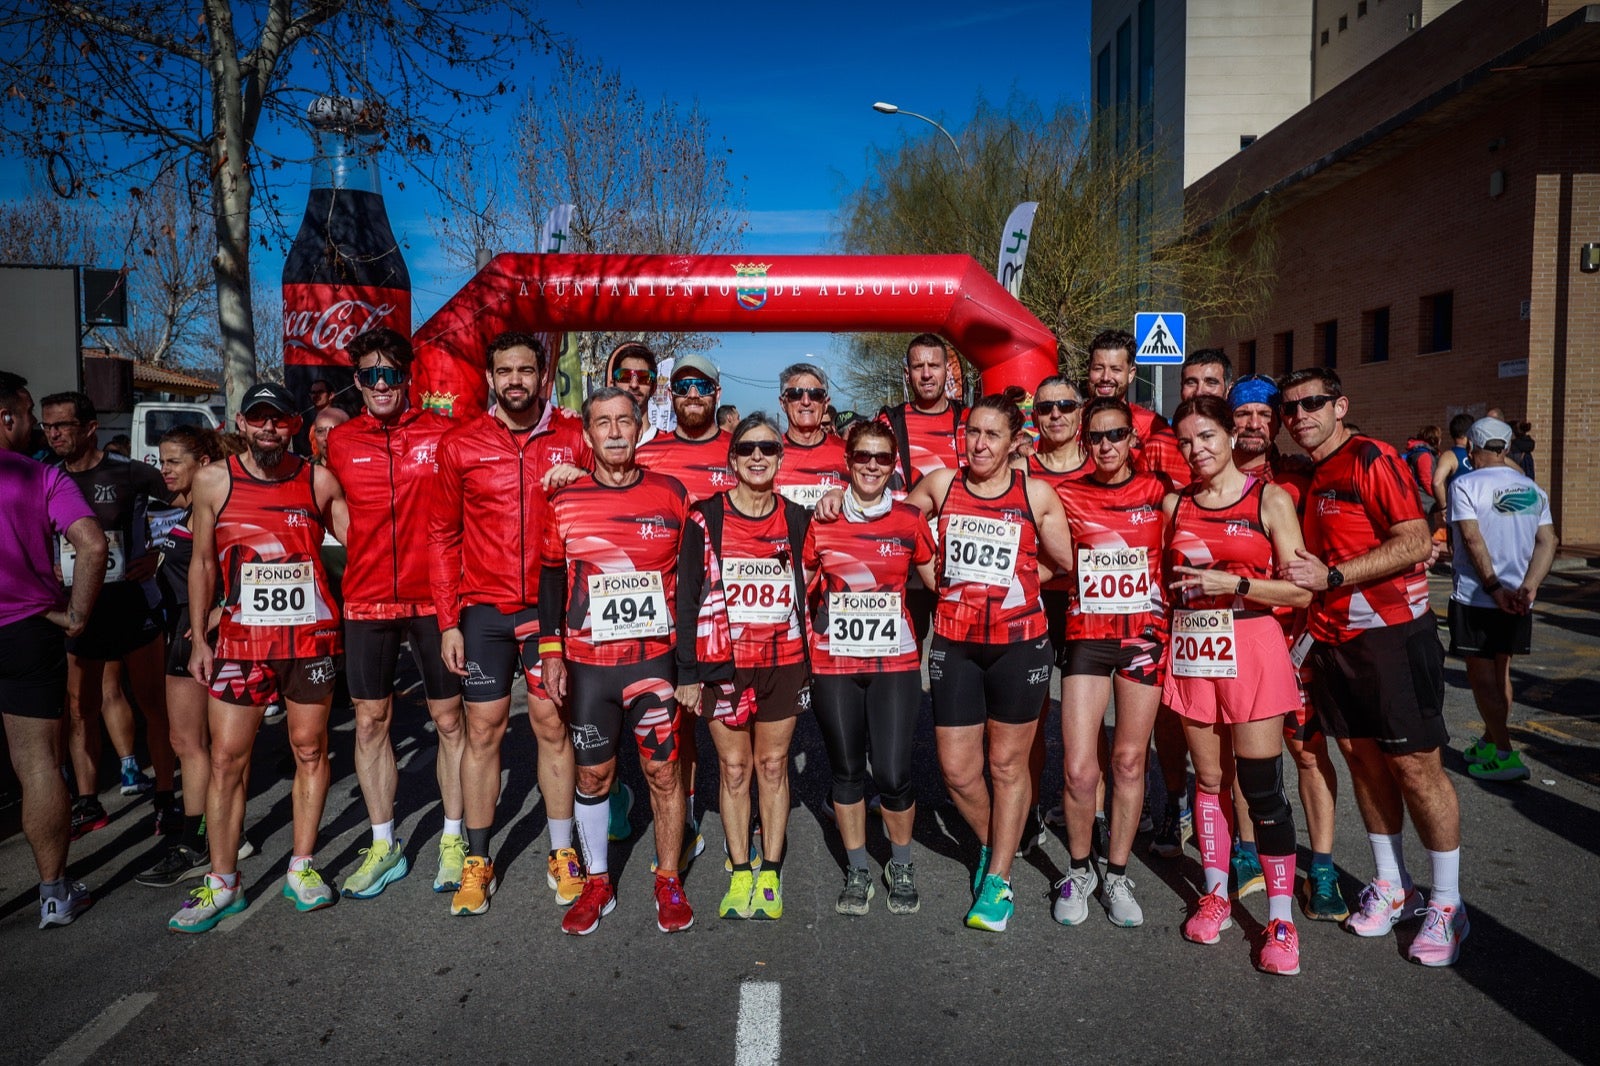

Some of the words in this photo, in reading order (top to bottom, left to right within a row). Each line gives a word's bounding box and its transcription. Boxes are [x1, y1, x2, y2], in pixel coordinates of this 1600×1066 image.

[519, 281, 730, 296] AYUNTAMIENTO
[773, 281, 802, 296] DE
[818, 280, 954, 296] ALBOLOTE
[962, 520, 1006, 537] FONDO
[950, 540, 1011, 571] 3085
[1095, 554, 1138, 566] FONDO
[257, 569, 302, 580] FONDO
[739, 564, 782, 576] FONDO
[604, 577, 650, 591] FONDO
[1083, 572, 1149, 598] 2064
[253, 587, 305, 612] 580
[726, 583, 791, 607] 2084
[844, 598, 887, 609] FONDO
[602, 595, 657, 624] 494
[834, 618, 897, 641] 3074
[1180, 616, 1219, 628] FONDO
[1174, 636, 1233, 661] 2042
[1200, 800, 1219, 863] kalenji
